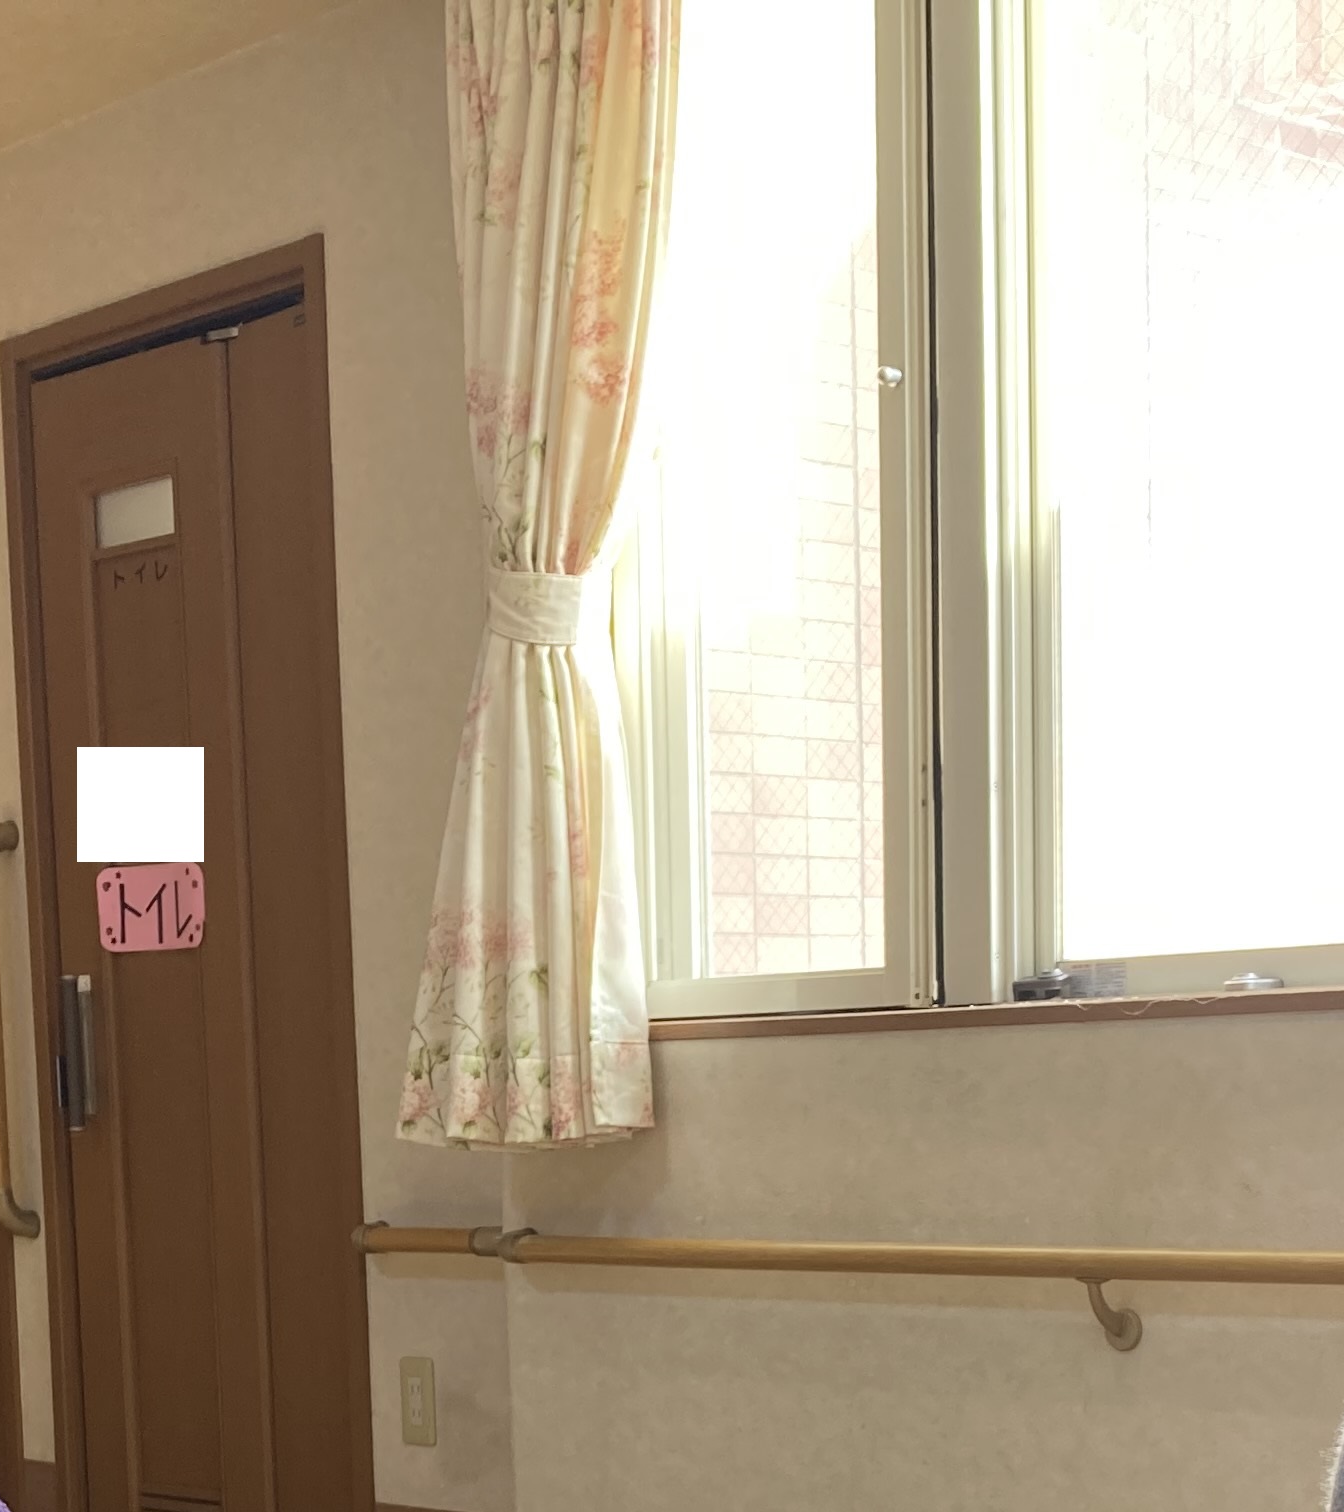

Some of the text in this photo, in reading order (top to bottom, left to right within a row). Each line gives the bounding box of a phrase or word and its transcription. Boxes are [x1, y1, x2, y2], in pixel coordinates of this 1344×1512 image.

[113, 561, 168, 591] トイレ
[119, 880, 193, 944] トイレ
